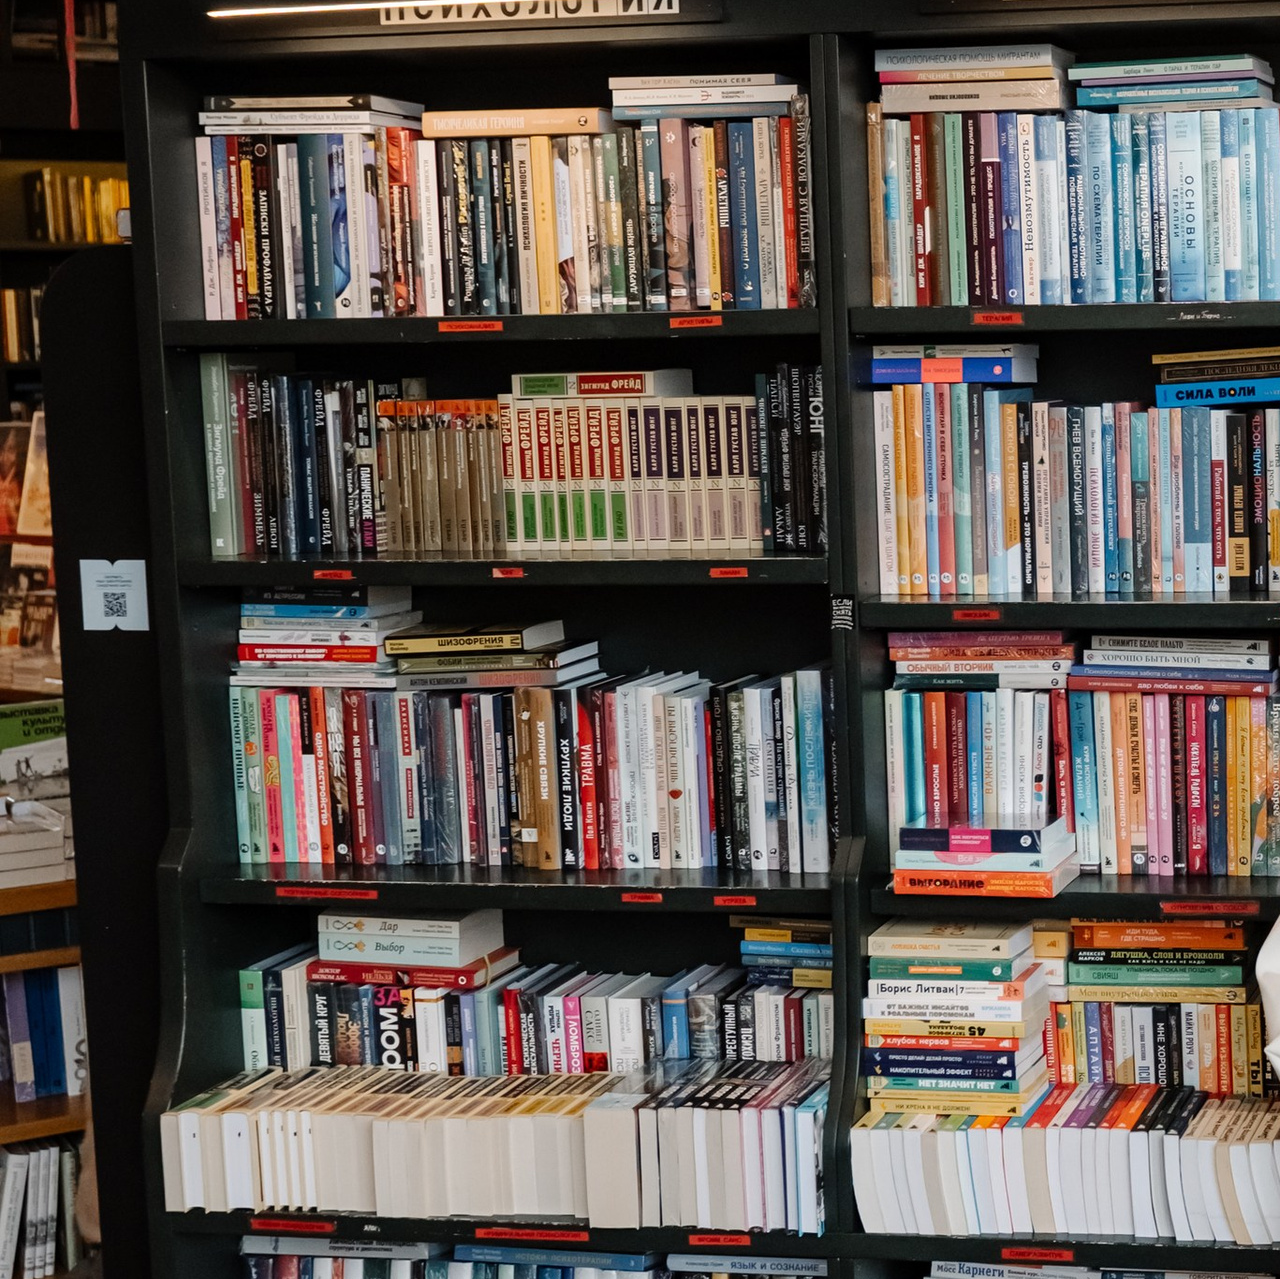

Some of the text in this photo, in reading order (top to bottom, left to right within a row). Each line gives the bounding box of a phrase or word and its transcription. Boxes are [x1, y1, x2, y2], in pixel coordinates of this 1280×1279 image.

[518, 160, 531, 250] ПСИХОЛОГИЯ ЛИЧНОСТИ
[718, 179, 729, 227] АРХЕТИПЫ
[796, 122, 810, 253] БЕГУЩАЯ С ВОЛКАМИ
[1021, 139, 1035, 251] Невозмутимость
[1184, 175, 1196, 249] ОСНОВЫ
[259, 190, 273, 304] ЗАПИСКИ ПРОФАЙЛЕРА
[626, 219, 638, 294] ДАРУЮЩАЯ ЖИЗНЬ
[758, 398, 766, 431] ЛЮБОВЬ
[1175, 386, 1255, 401] СИЛА ВОЛИ
[213, 423, 226, 499] Зигмунд Фрейд
[247, 382, 263, 545] ФРЕЙД ЗИММЕЛЬ
[261, 380, 278, 548] ФРЕЙД ЛЕБОН
[314, 389, 332, 545] ФРЕЙД ФРЕЙД
[519, 412, 533, 478] ЗИГМУНД ФРЕЙД
[588, 411, 601, 477] ЗИГМУНД ФРЕЙД
[728, 411, 739, 473] КАРЛ ГУСТАВ ЮНГ
[759, 439, 768, 473] БЕЗУМИЕ
[359, 467, 374, 547] ПАНИЧЕСКИЕ АТАКИ
[1213, 467, 1222, 499] Работай
[437, 636, 504, 647] ШИЗОФРЕНИЯ
[907, 662, 994, 672] ОБЫЧНЫЙ ВТОРНИК
[400, 701, 410, 753] ЗАВИСИМАЯ
[315, 732, 328, 826] ОДНО РАССТРОЙСТВО
[537, 721, 549, 799] ХРУПКИЕ СВЯЗИ
[560, 739, 574, 830] ХРУПКИЕ ЛЮДИ
[582, 744, 593, 787] ТРАВМА
[1273, 743, 1280, 775] стать
[585, 802, 594, 839] Пол Конти
[374, 940, 405, 955] Выбор
[379, 919, 399, 934] Дар
[880, 983, 955, 995] Борис Литвак
[315, 994, 331, 1062] ДЕВЯТЫЙ КРУГ
[723, 1004, 737, 1060] ПРЕСТУПНЫЙ
[918, 1080, 995, 1089] НЕТ ЗНАЧИТ НЕТ
[731, 1261, 753, 1272] ЯЗЫК
[768, 1262, 820, 1275] СОЗНАНИЕ
[958, 1264, 1004, 1278] Карнеги
